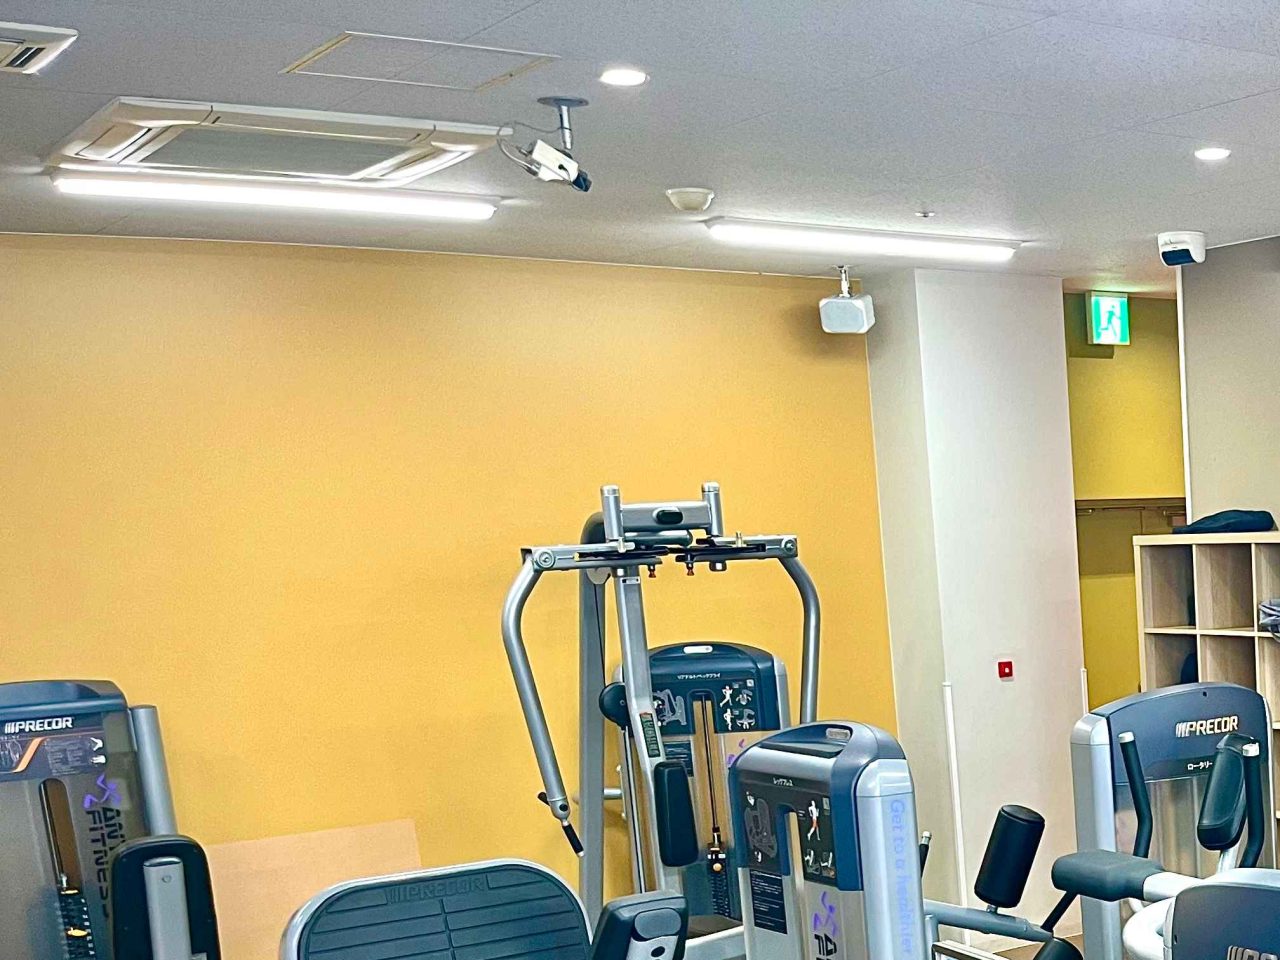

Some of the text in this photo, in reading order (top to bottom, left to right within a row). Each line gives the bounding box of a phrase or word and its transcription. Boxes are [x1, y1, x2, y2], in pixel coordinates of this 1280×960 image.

[14, 716, 73, 733] PRECOR
[1183, 716, 1238, 737] PRECOR
[1188, 761, 1213, 770] ロータリー
